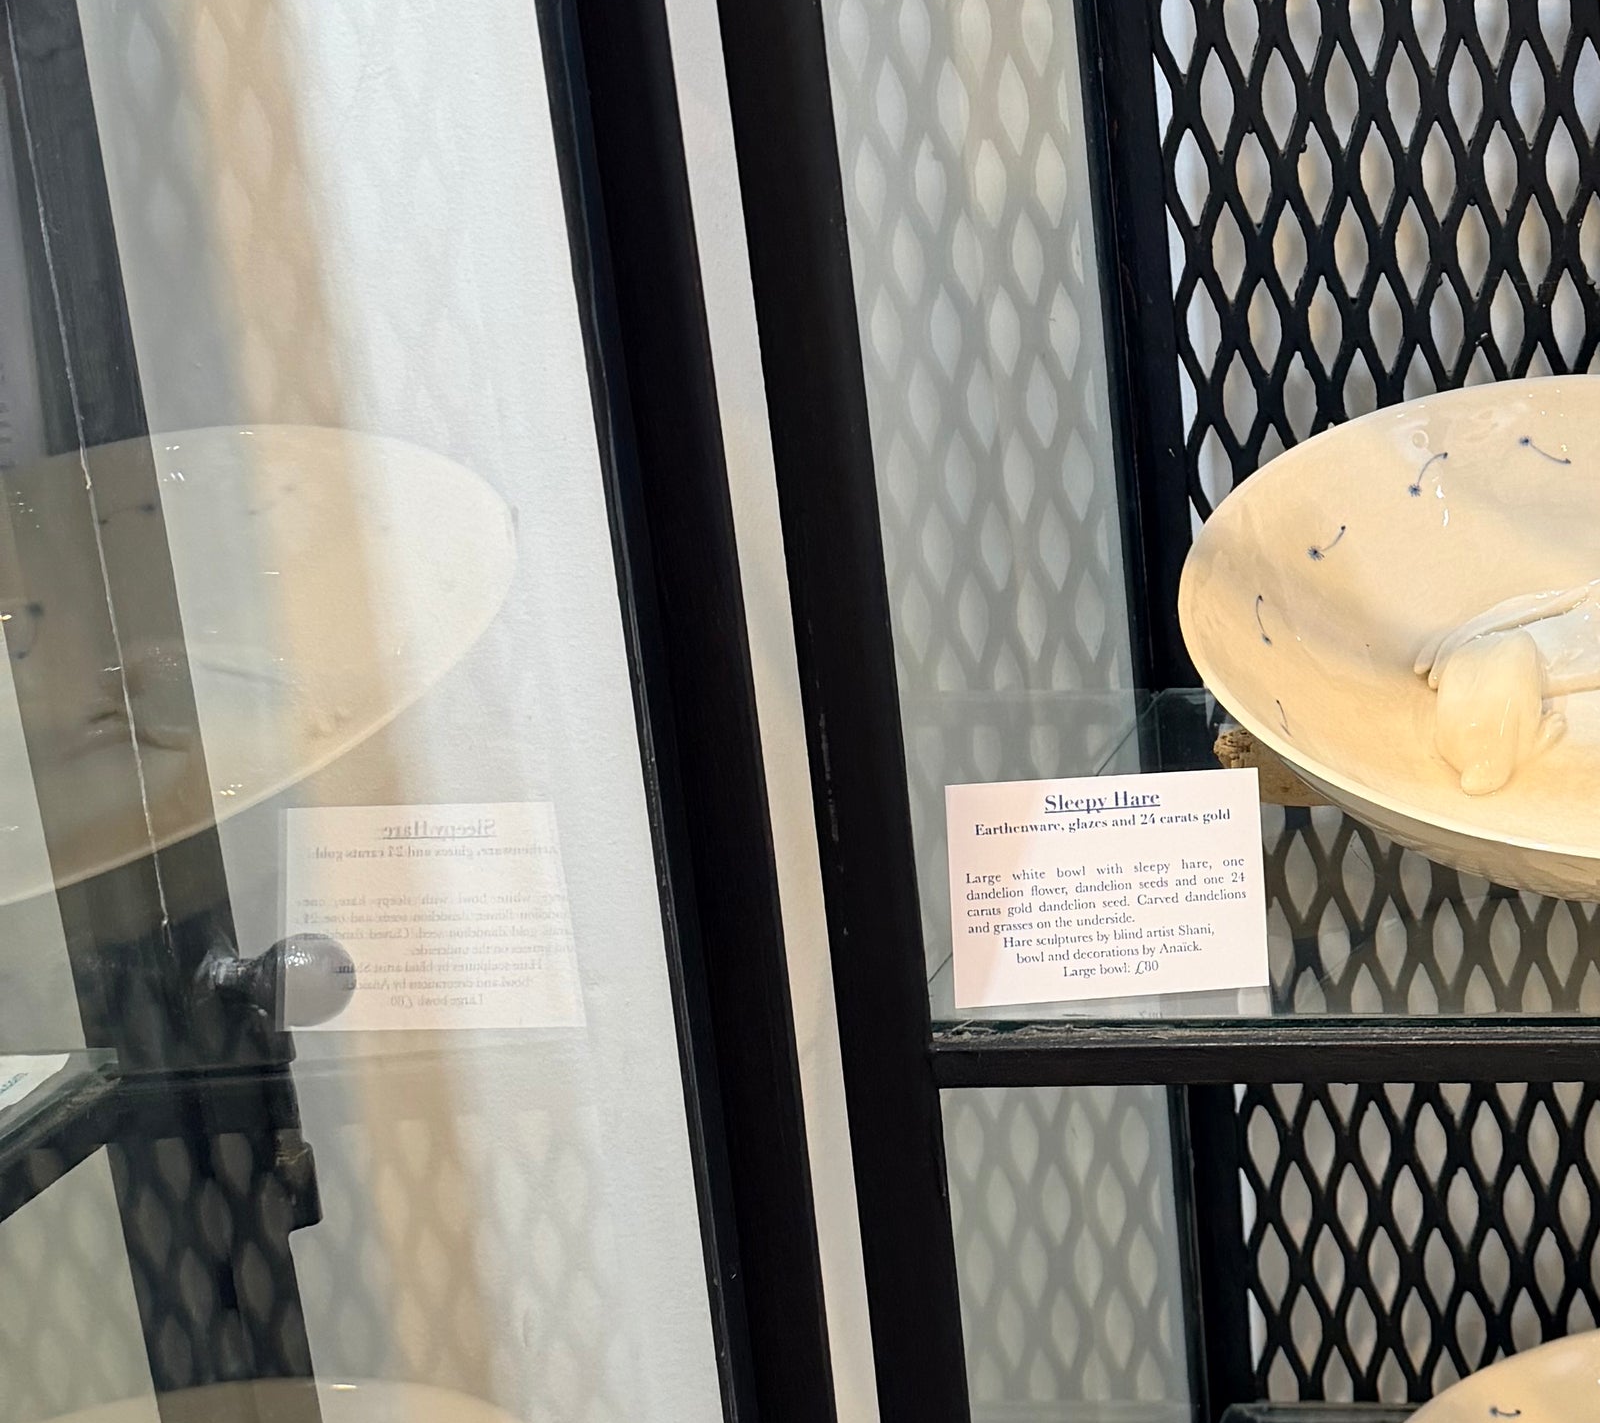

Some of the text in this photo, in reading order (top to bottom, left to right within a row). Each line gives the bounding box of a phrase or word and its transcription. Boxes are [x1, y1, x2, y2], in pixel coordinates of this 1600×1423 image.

[1045, 790, 1160, 814] Sleepy Hare
[974, 808, 1230, 836] Earthenware, glazes and 24 carats gold
[1063, 965, 1096, 979] Large
[1099, 961, 1130, 975] bowl:
